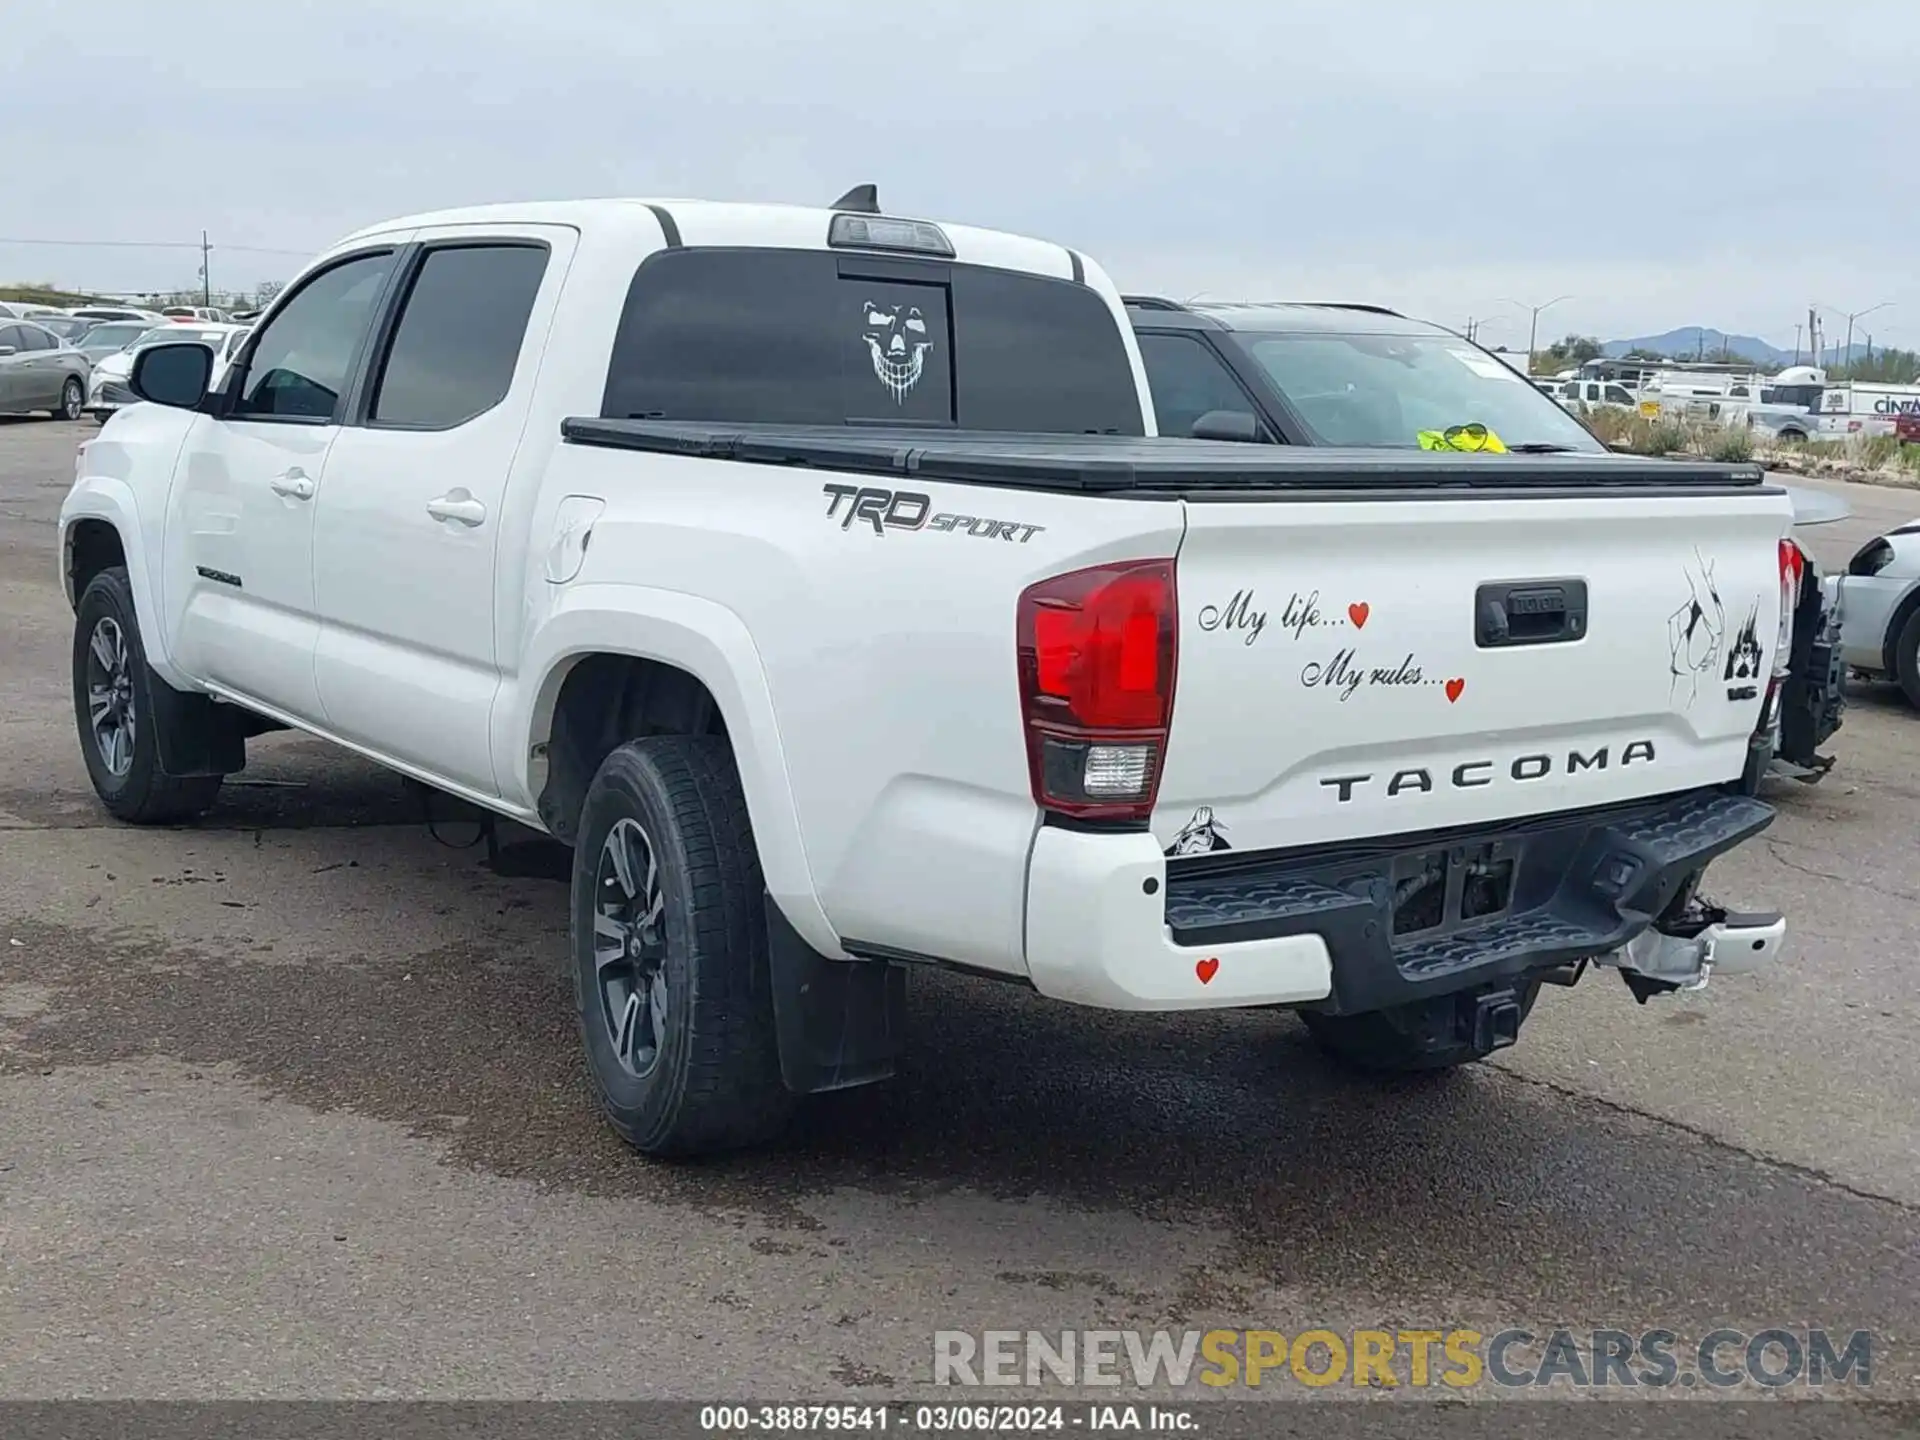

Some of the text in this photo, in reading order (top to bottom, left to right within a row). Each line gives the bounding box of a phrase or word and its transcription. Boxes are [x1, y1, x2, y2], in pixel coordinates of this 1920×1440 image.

[823, 483, 1046, 544] TRD SPORT
[1199, 589, 1266, 646] My
[1300, 648, 1363, 702] My
[1319, 739, 1656, 803] TACOMA
